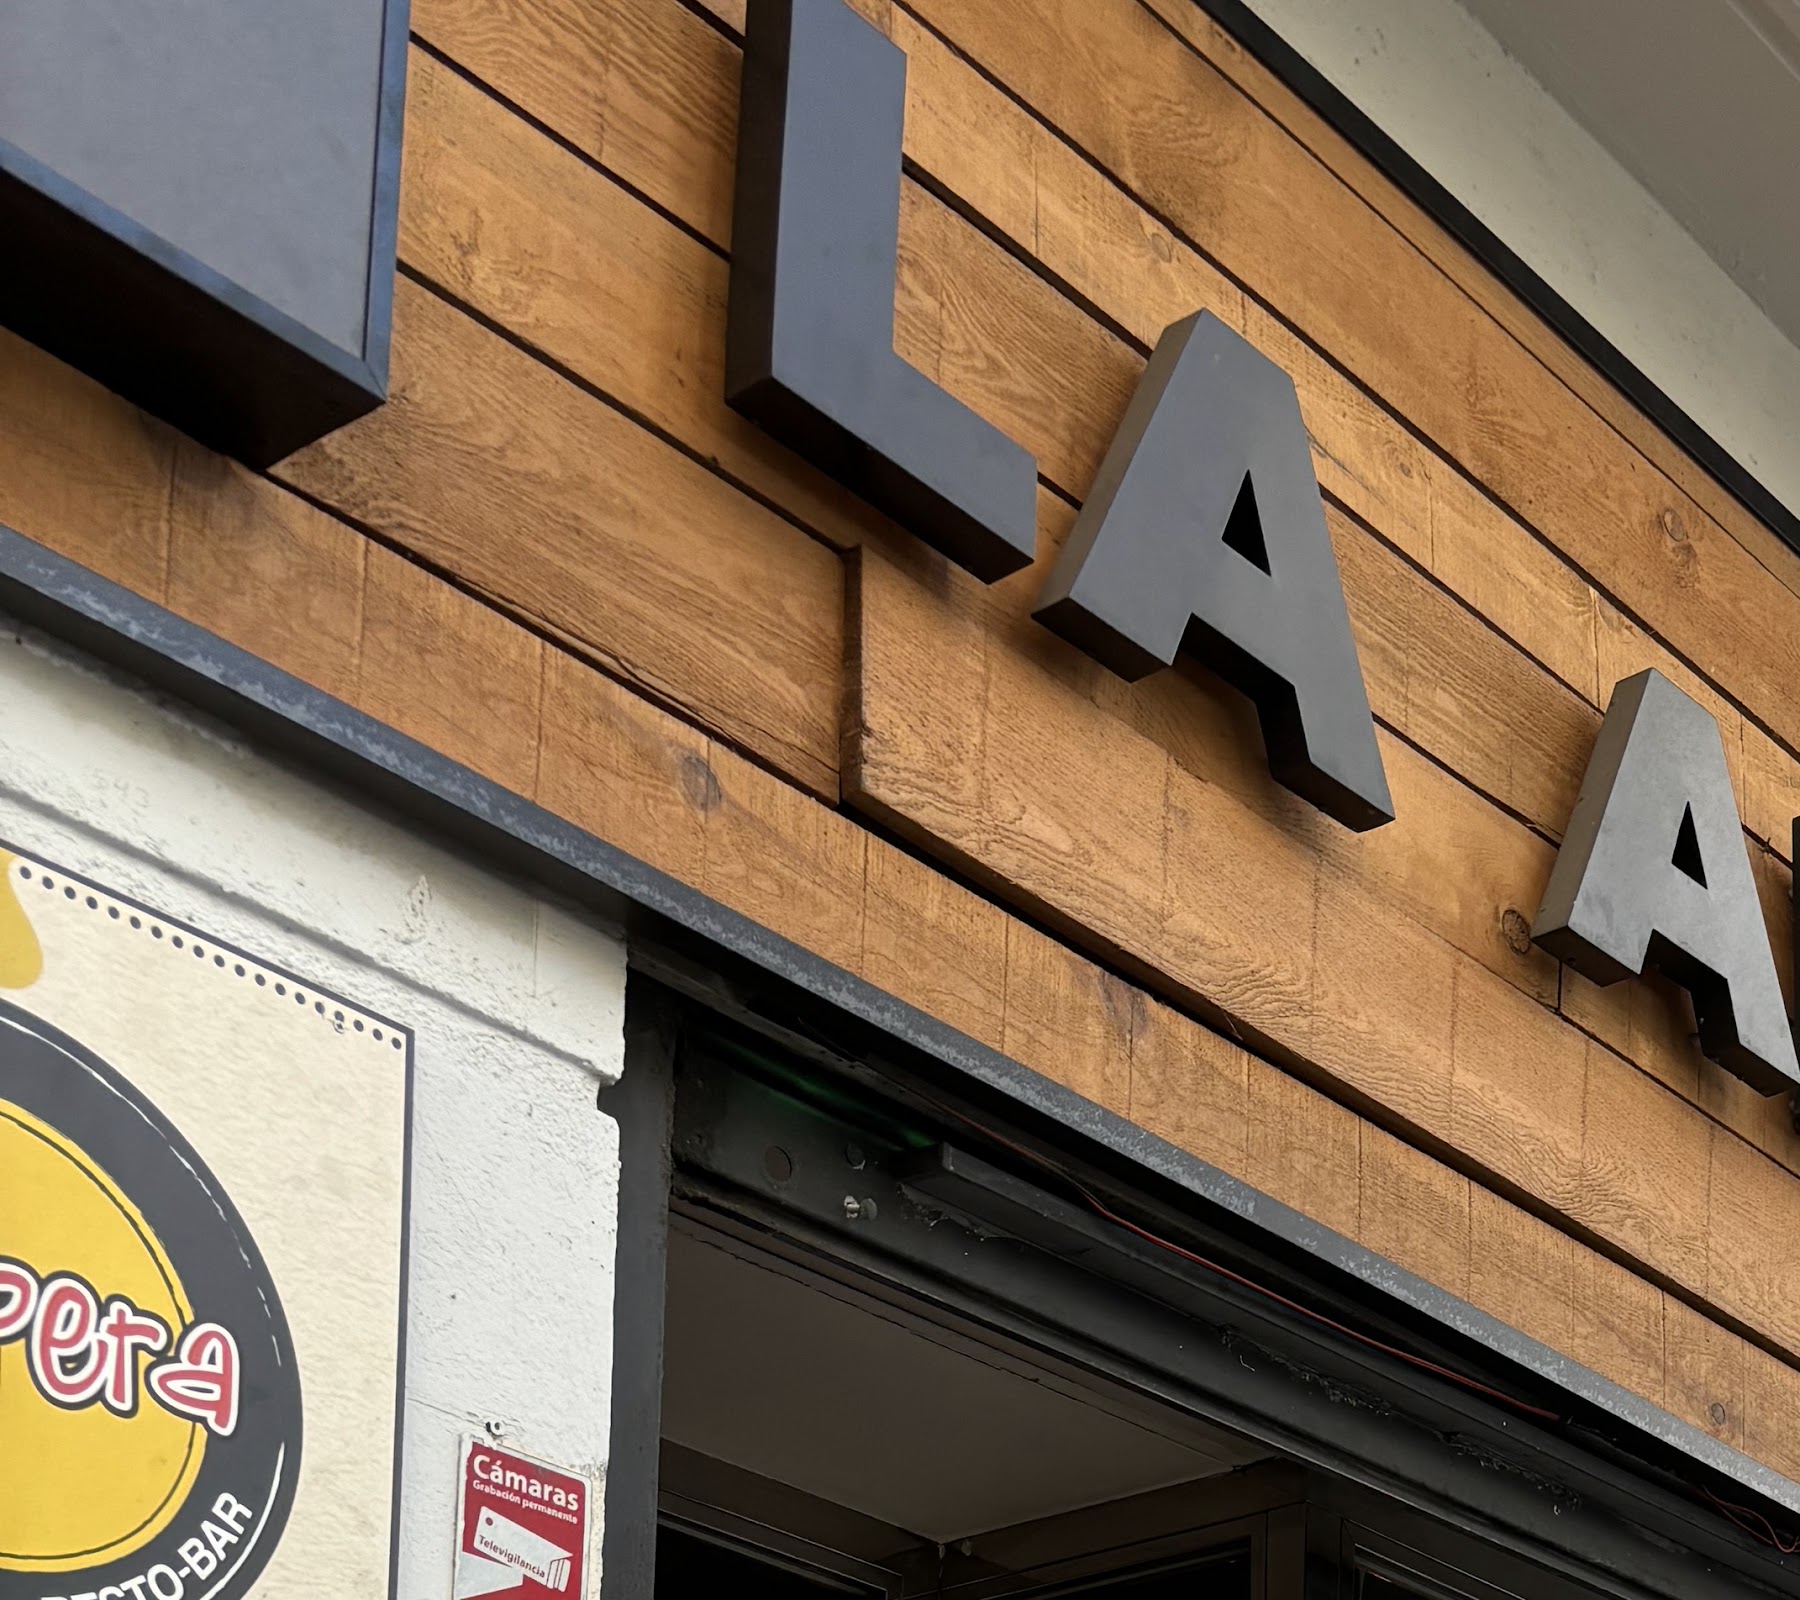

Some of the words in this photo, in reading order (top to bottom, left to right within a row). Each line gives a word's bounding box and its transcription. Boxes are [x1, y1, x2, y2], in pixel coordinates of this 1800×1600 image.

[725, 0, 1395, 832] LA
[473, 1455, 578, 1511] Cámaras
[473, 1480, 520, 1505] Grabación
[521, 1496, 577, 1524] permanente
[479, 1535, 545, 1577] Televigilancia
